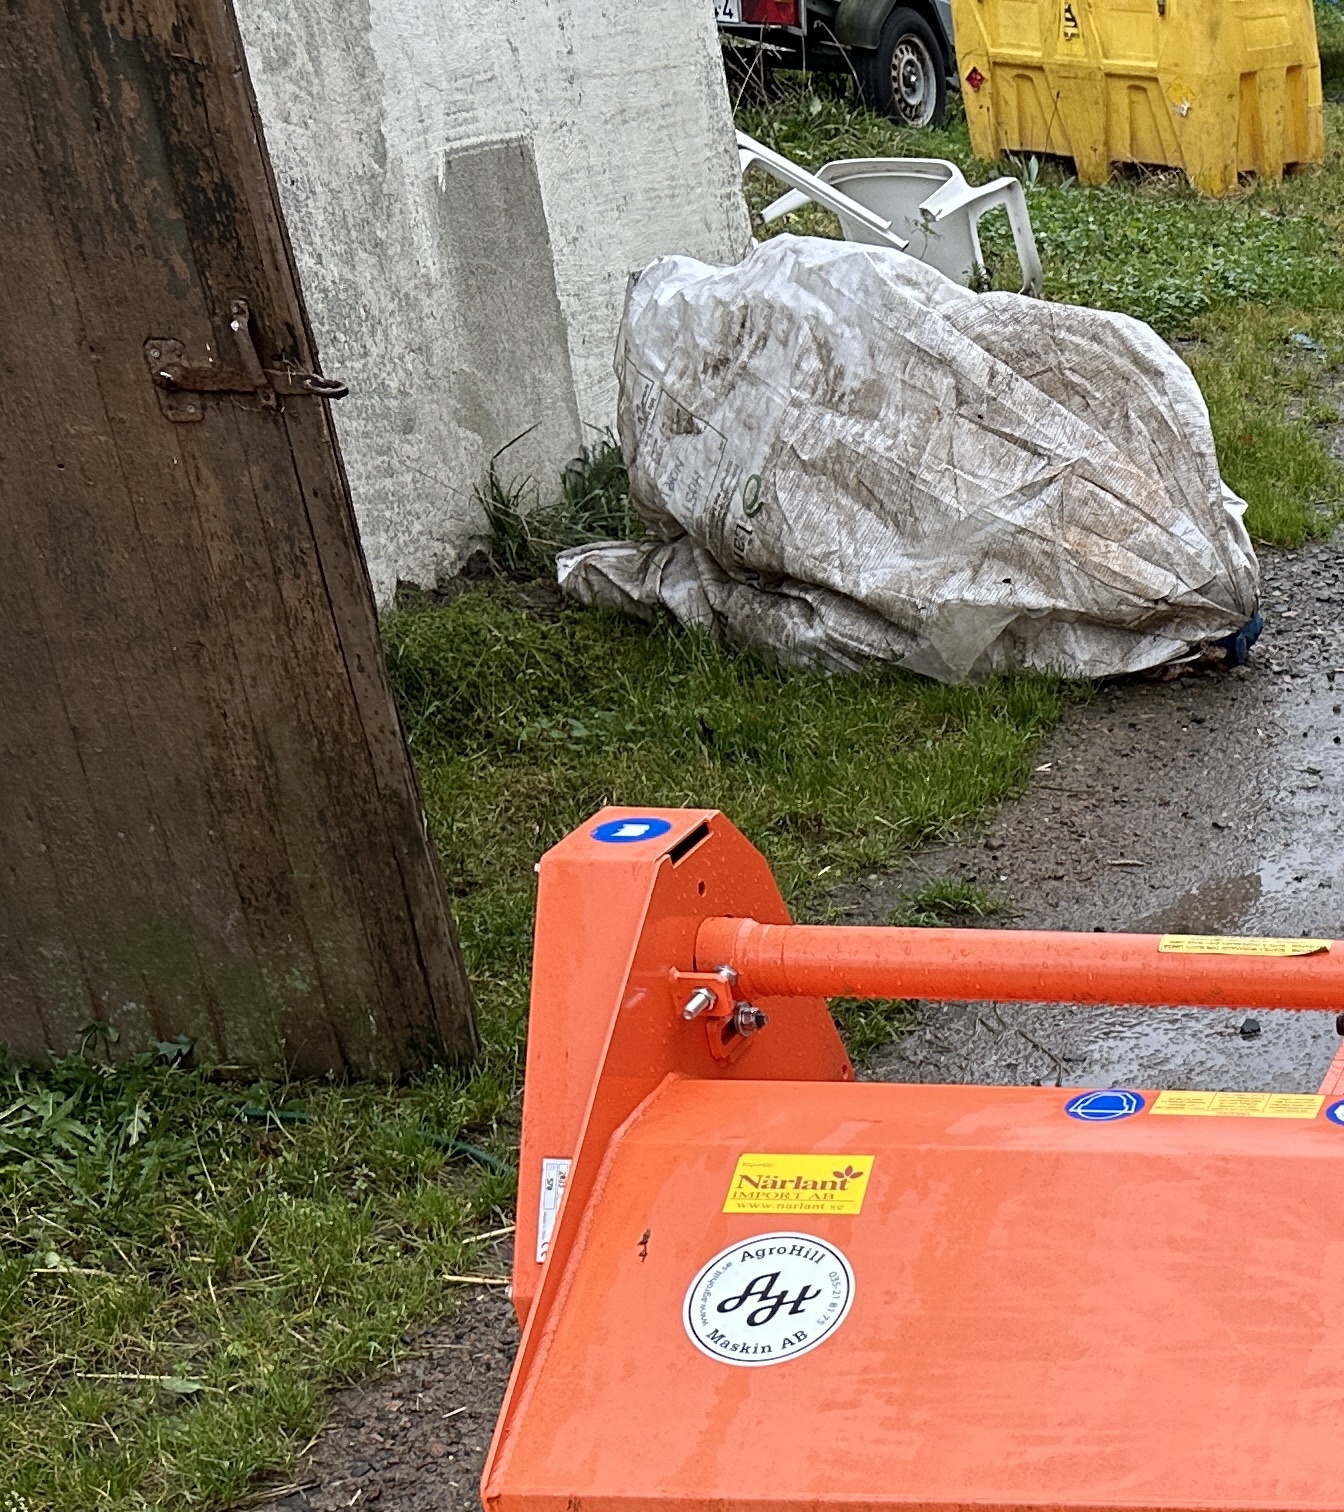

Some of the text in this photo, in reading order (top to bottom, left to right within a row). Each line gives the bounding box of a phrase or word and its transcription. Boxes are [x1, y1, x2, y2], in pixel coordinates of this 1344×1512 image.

[735, 1173, 850, 1191] Närlant
[732, 1192, 835, 1201] IMPORT AB
[740, 1244, 826, 1265] AgroHill
[705, 1328, 808, 1355] Maskin AB
